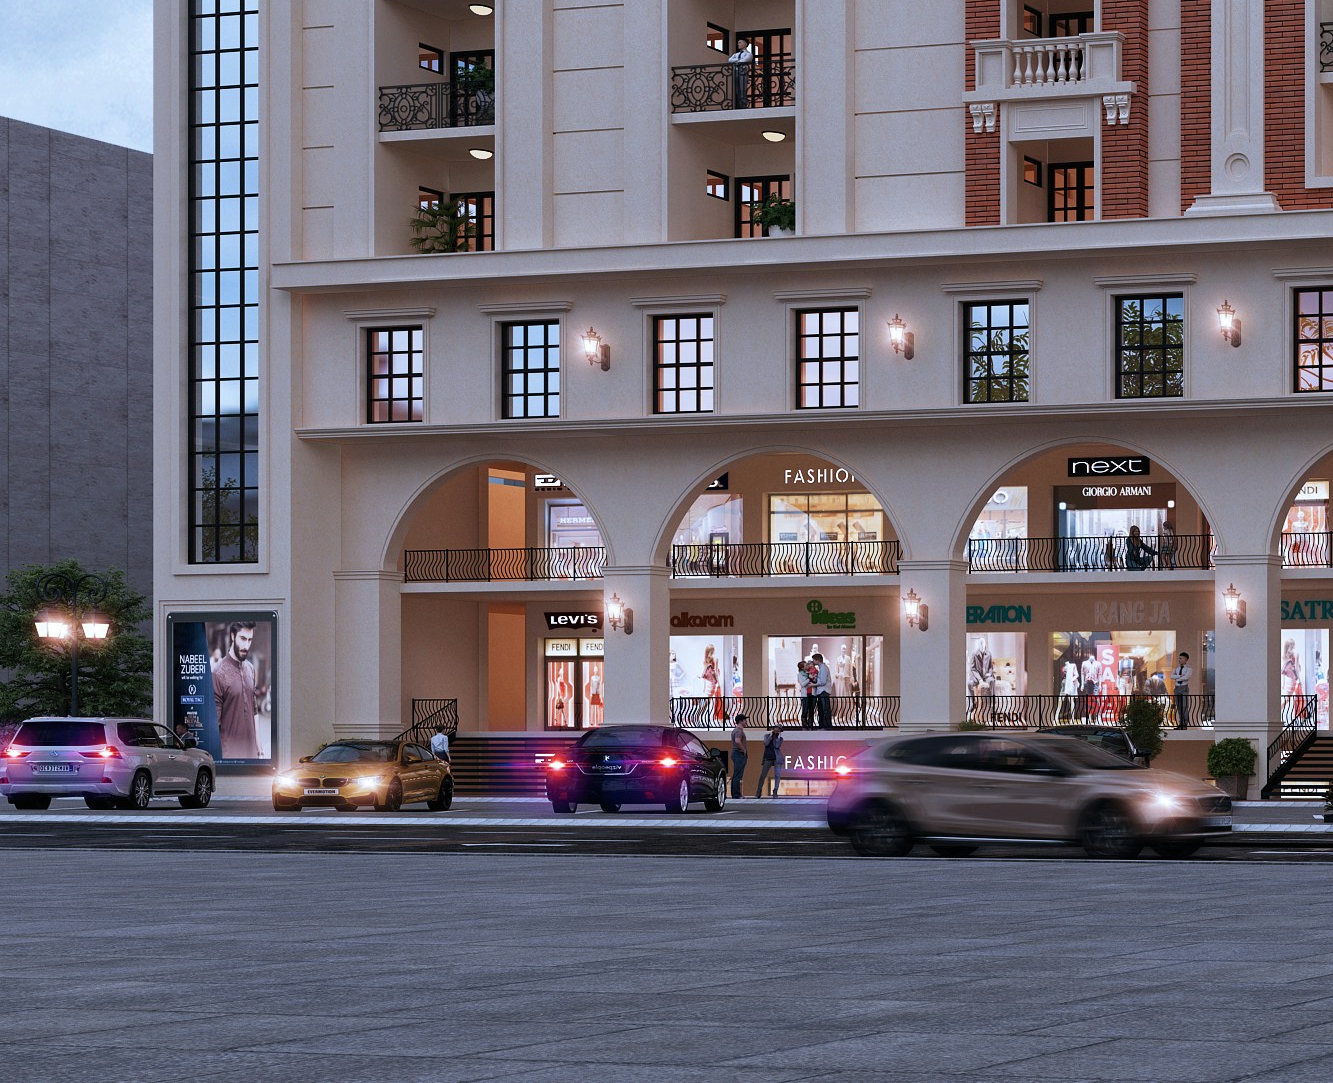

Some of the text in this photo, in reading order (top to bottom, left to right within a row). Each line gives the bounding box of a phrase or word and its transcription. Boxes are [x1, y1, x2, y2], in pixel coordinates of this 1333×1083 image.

[1072, 459, 1143, 474] next
[1082, 486, 1151, 497] GIORGIO ARMANI
[560, 516, 595, 524] HERME
[551, 643, 571, 651] FENDI
[586, 643, 604, 651] FEND
[179, 654, 207, 664] NABEEL
[180, 664, 206, 674] ZUBERI
